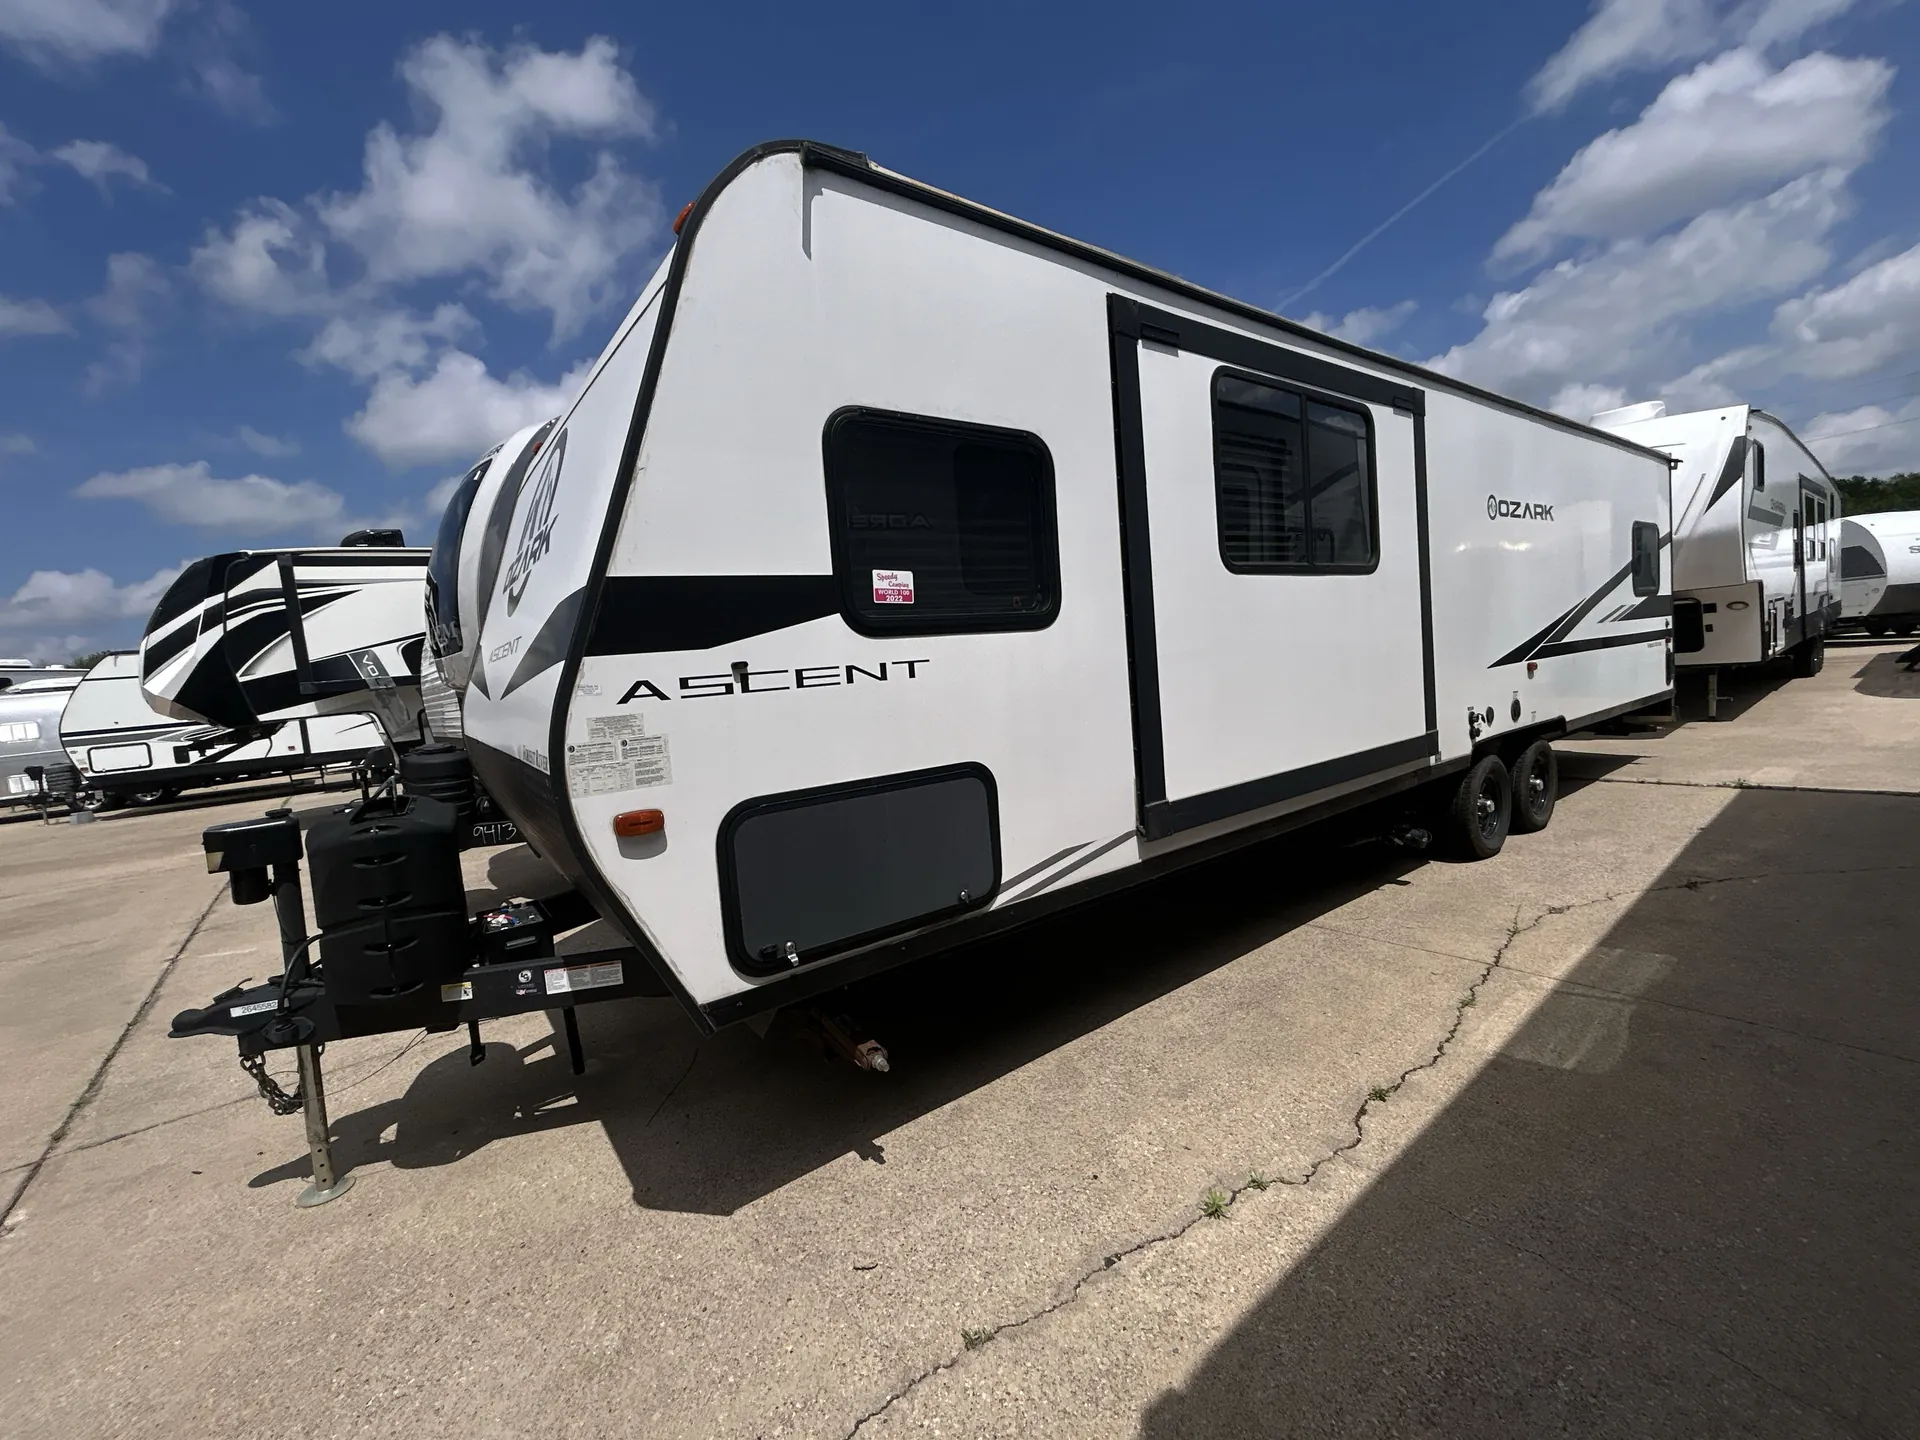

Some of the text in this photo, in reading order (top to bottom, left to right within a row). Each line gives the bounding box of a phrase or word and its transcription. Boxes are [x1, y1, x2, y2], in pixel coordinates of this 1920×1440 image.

[1498, 499, 1554, 521] OZARK
[503, 513, 559, 594] OZARK
[488, 635, 523, 665] ASCENT
[616, 659, 930, 705] ASCENT
[473, 822, 517, 844] 9413
[241, 1001, 277, 1014] 2645582
